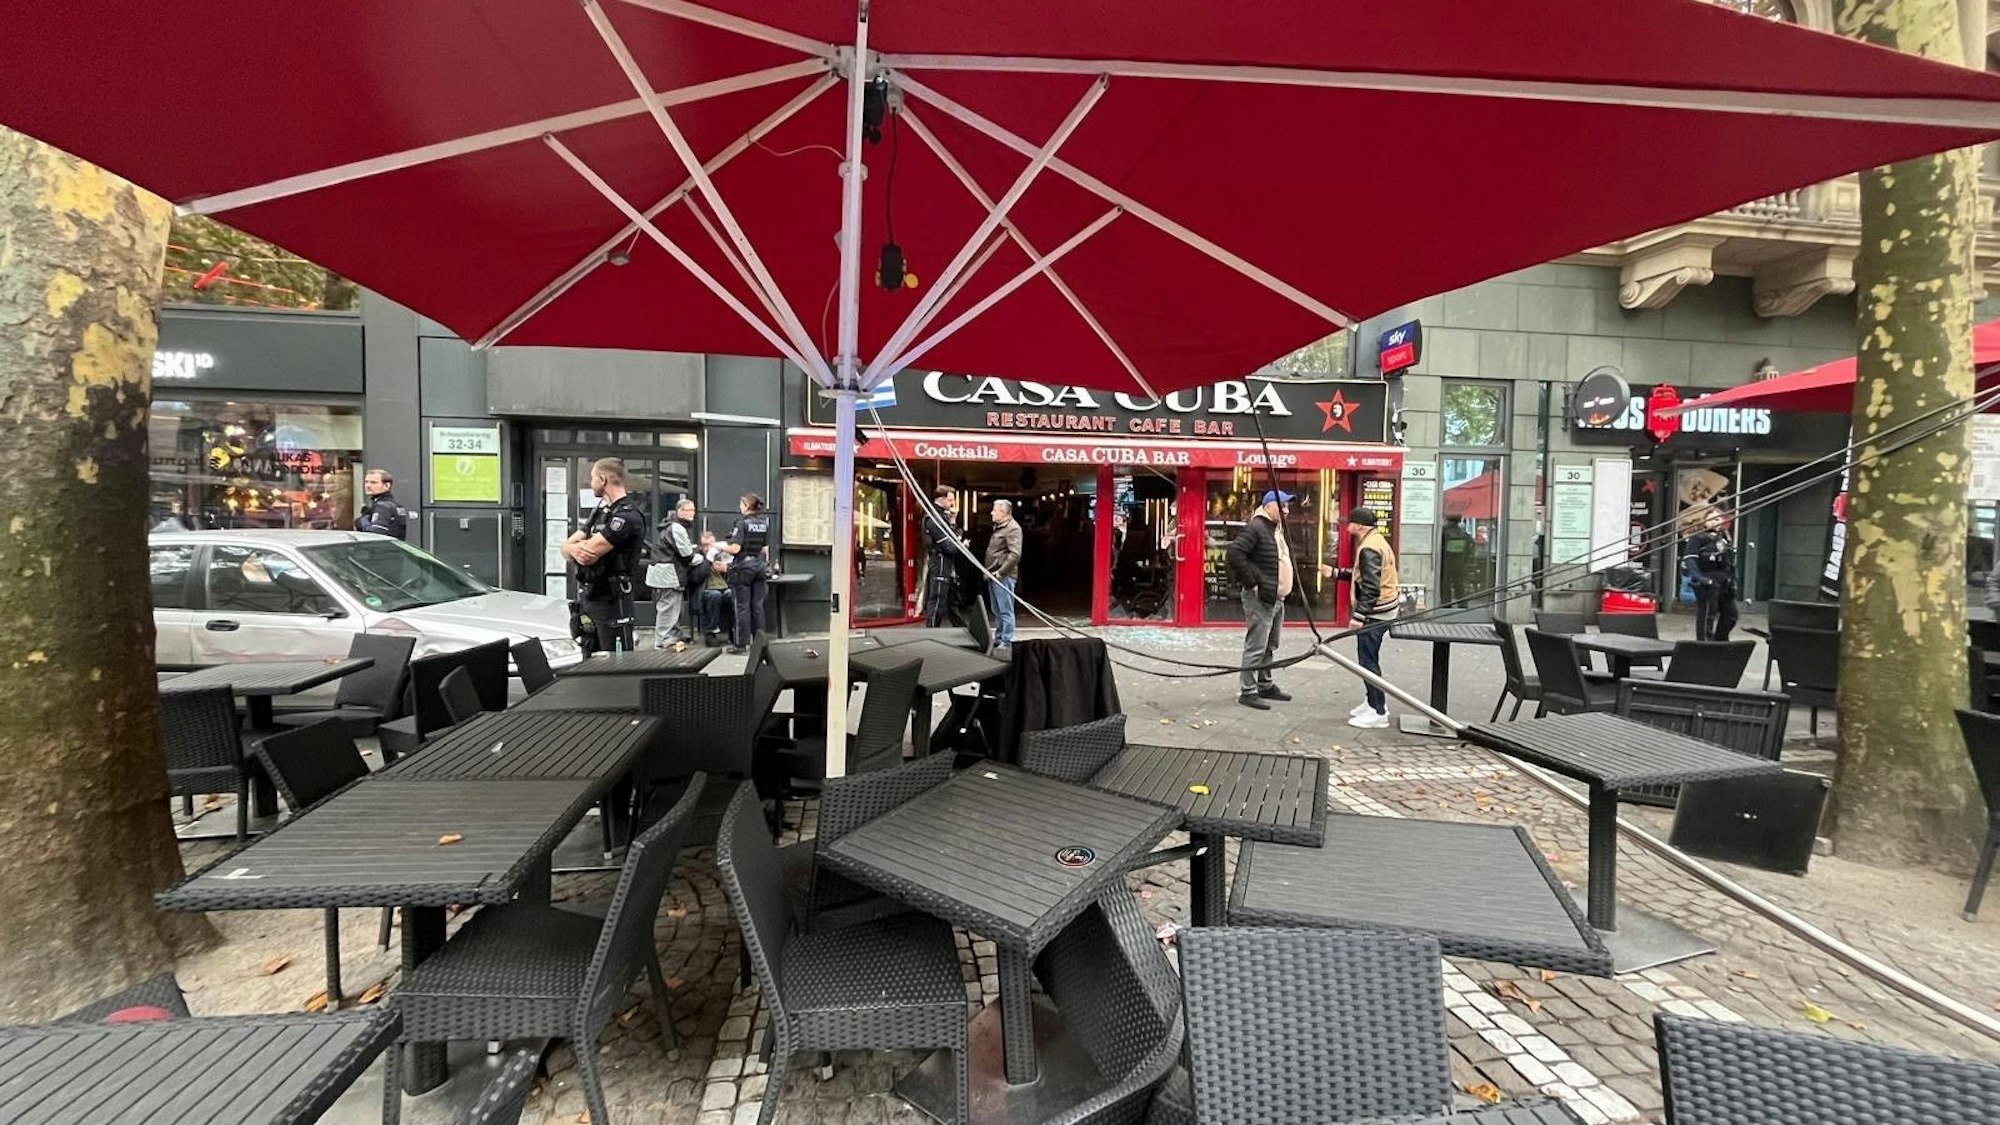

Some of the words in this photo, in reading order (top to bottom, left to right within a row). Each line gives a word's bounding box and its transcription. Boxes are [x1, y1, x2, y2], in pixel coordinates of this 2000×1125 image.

[1388, 330, 1406, 345] sky
[923, 371, 1100, 408] CASA
[986, 412, 1116, 431] RESTAURANT
[1129, 417, 1181, 433] CAFE
[1194, 419, 1234, 435] BAR
[448, 439, 482, 450] 32-34
[914, 442, 998, 459] Cocktails
[1041, 448, 1089, 463] CASA
[1092, 447, 1149, 464] CUBA
[1153, 450, 1190, 465] BAR
[1236, 451, 1296, 467] Lounge
[1412, 467, 1426, 476] 30
[1567, 471, 1580, 480] 30
